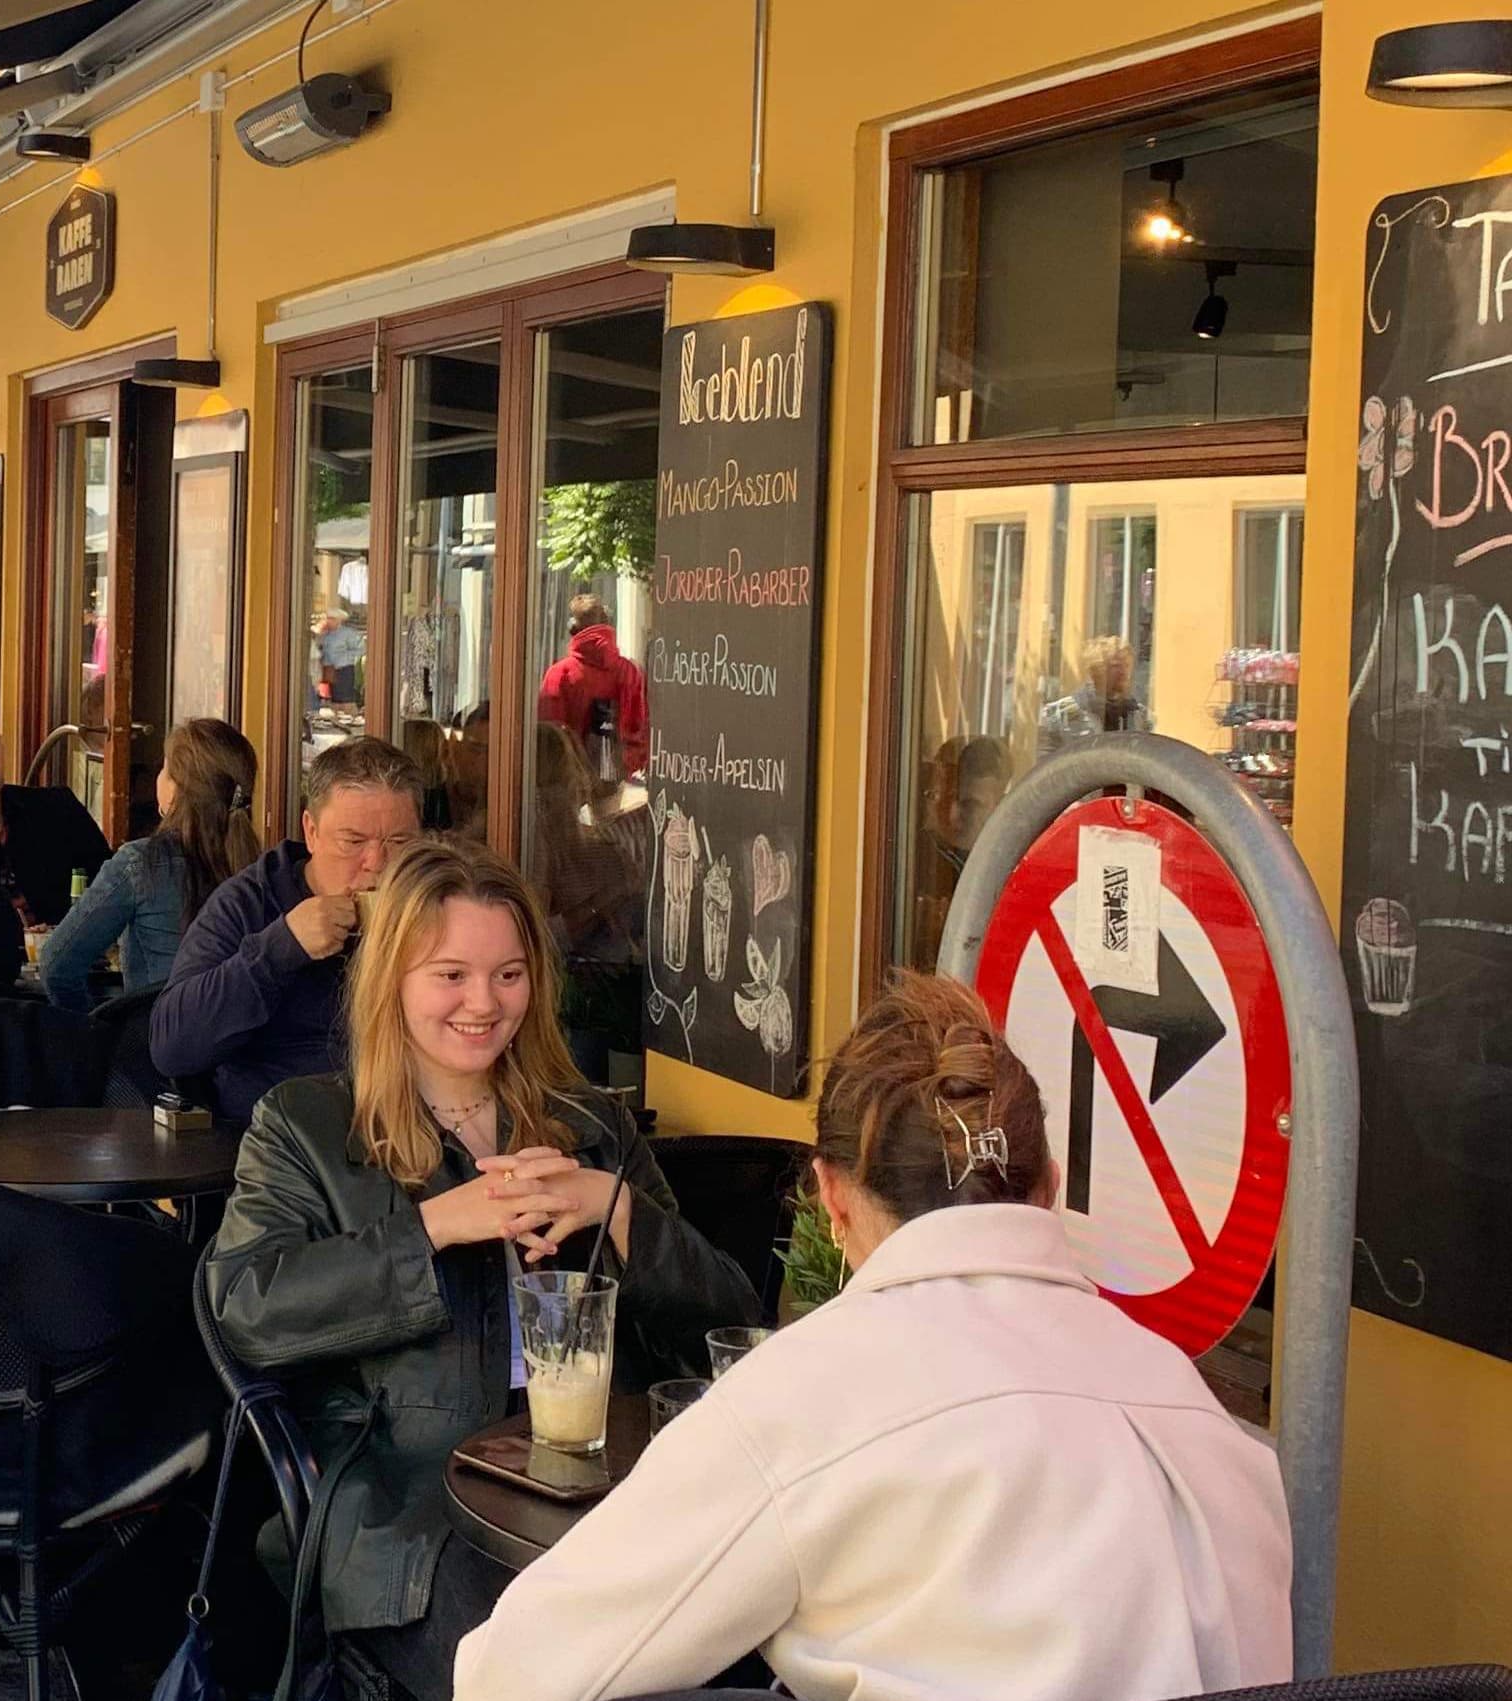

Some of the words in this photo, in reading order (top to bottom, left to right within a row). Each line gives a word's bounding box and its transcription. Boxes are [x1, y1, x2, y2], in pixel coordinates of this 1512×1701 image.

[58, 213, 93, 257] KAFFE
[56, 251, 93, 296] BAREN
[679, 308, 808, 426] Iceblend
